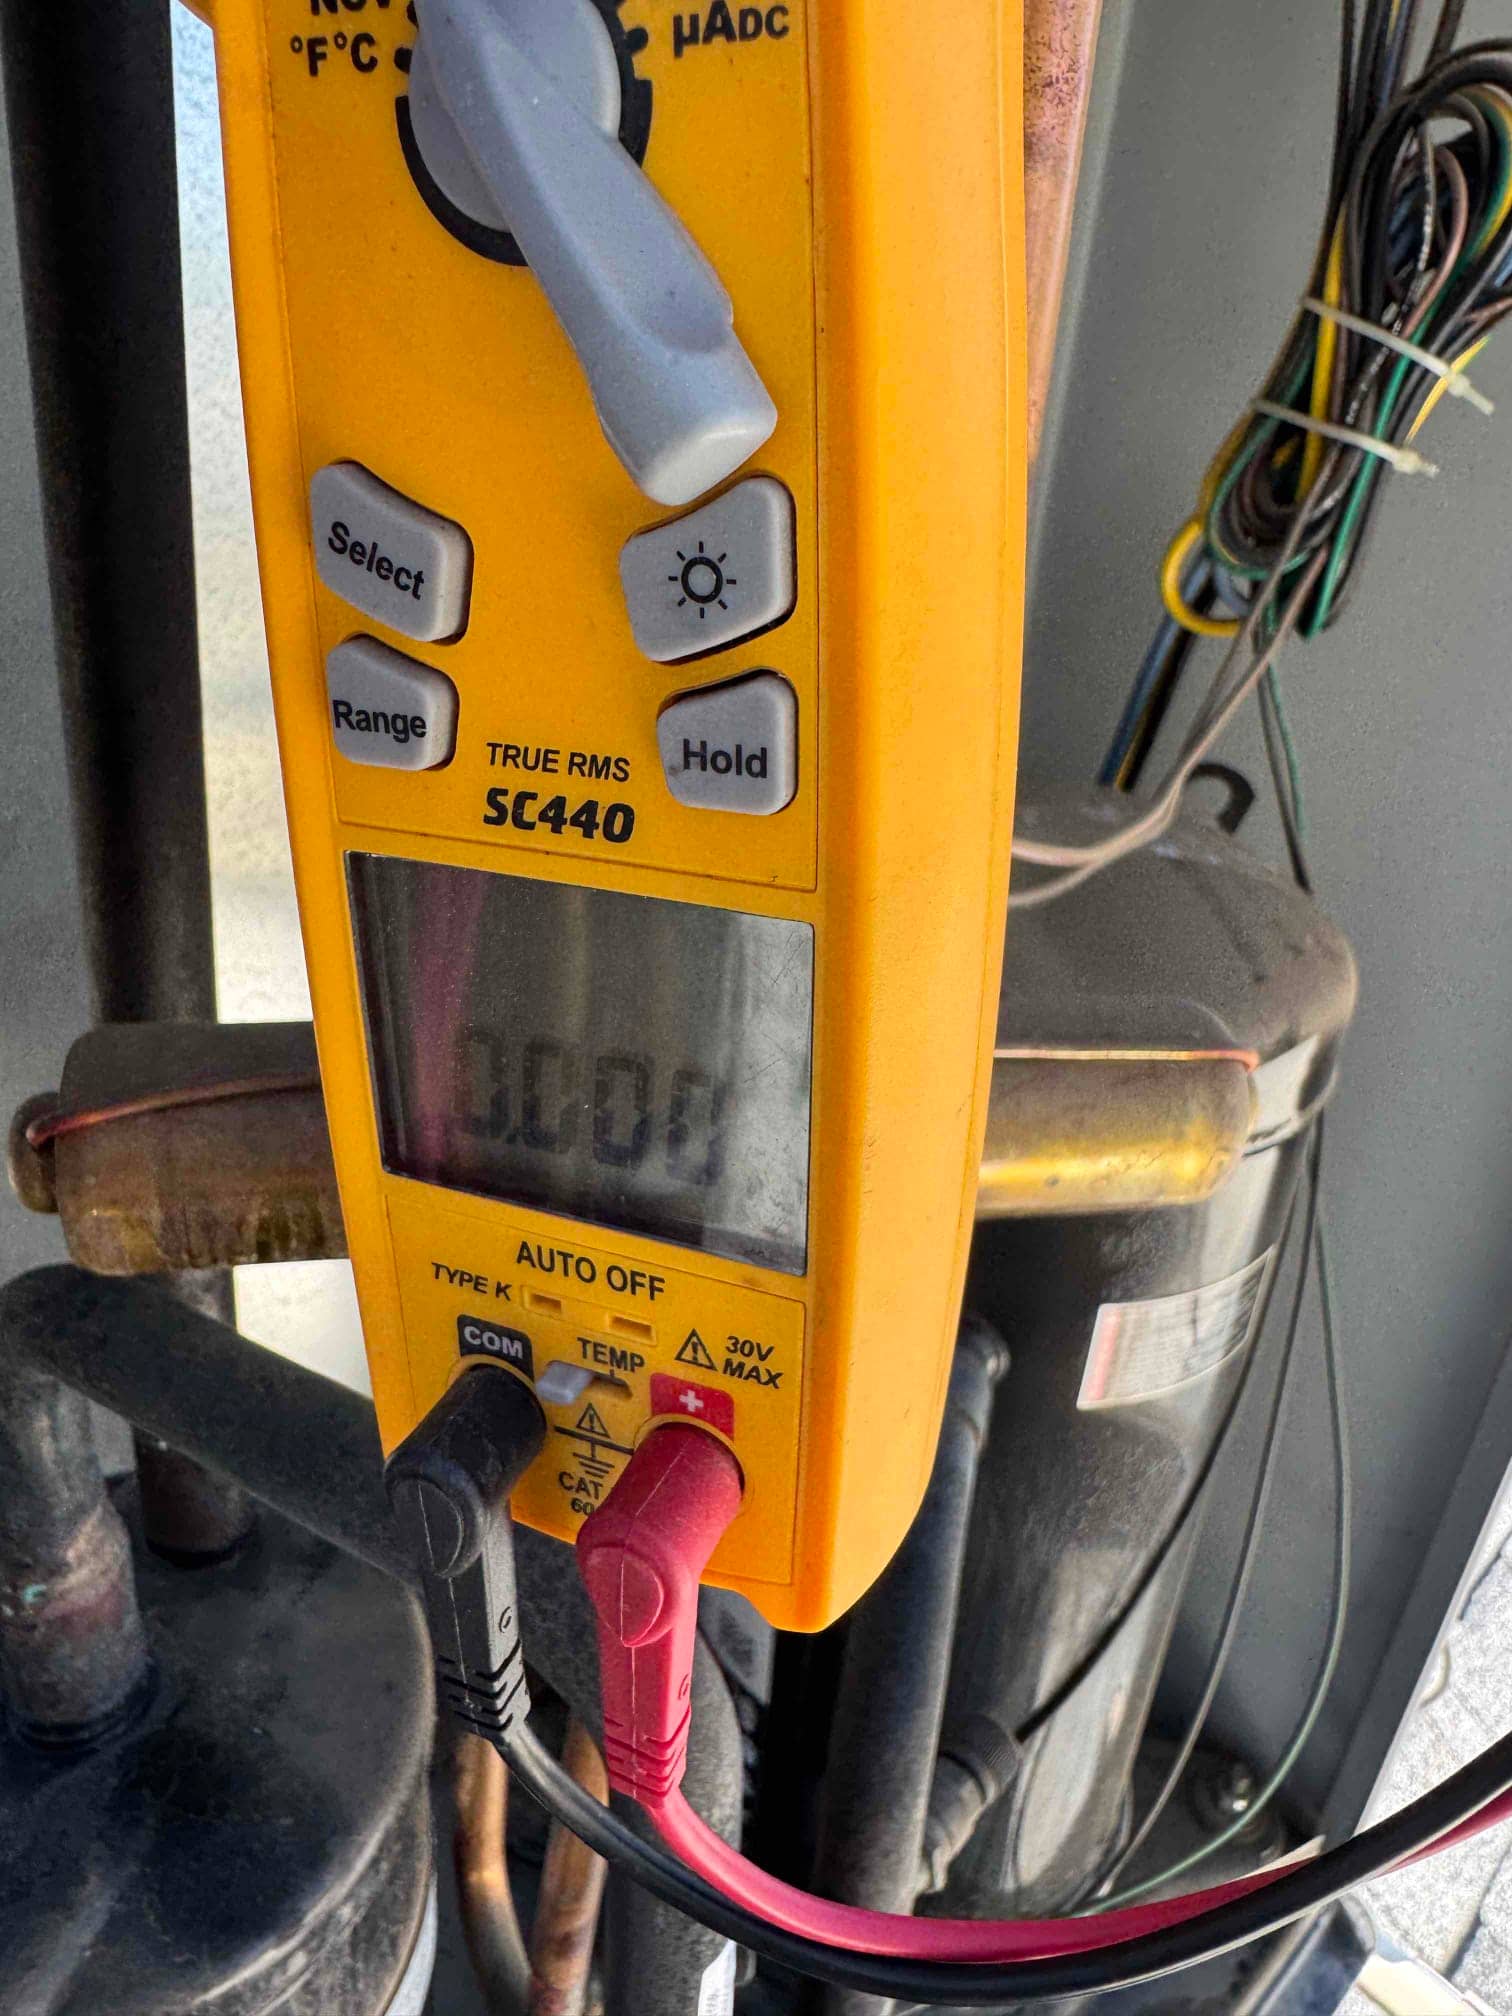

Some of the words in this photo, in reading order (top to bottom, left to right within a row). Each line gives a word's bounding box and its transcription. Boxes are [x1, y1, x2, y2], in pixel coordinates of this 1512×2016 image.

[328, 521, 424, 600] Select
[333, 699, 427, 743] Range
[487, 742, 560, 774] TRUE
[567, 754, 631, 782] RMS
[683, 738, 768, 779] Hold
[483, 788, 635, 843] SC440
[431, 1262, 489, 1294] TYPE
[495, 1281, 513, 1300] K
[516, 1241, 597, 1284] AUTO
[606, 1265, 666, 1301] OFF
[463, 1325, 524, 1359] COM
[576, 1337, 645, 1373] TEMP
[725, 1335, 775, 1362] 30V
[722, 1357, 784, 1389] MAX
[559, 1471, 604, 1500] CAT
[571, 1497, 595, 1515] 60
